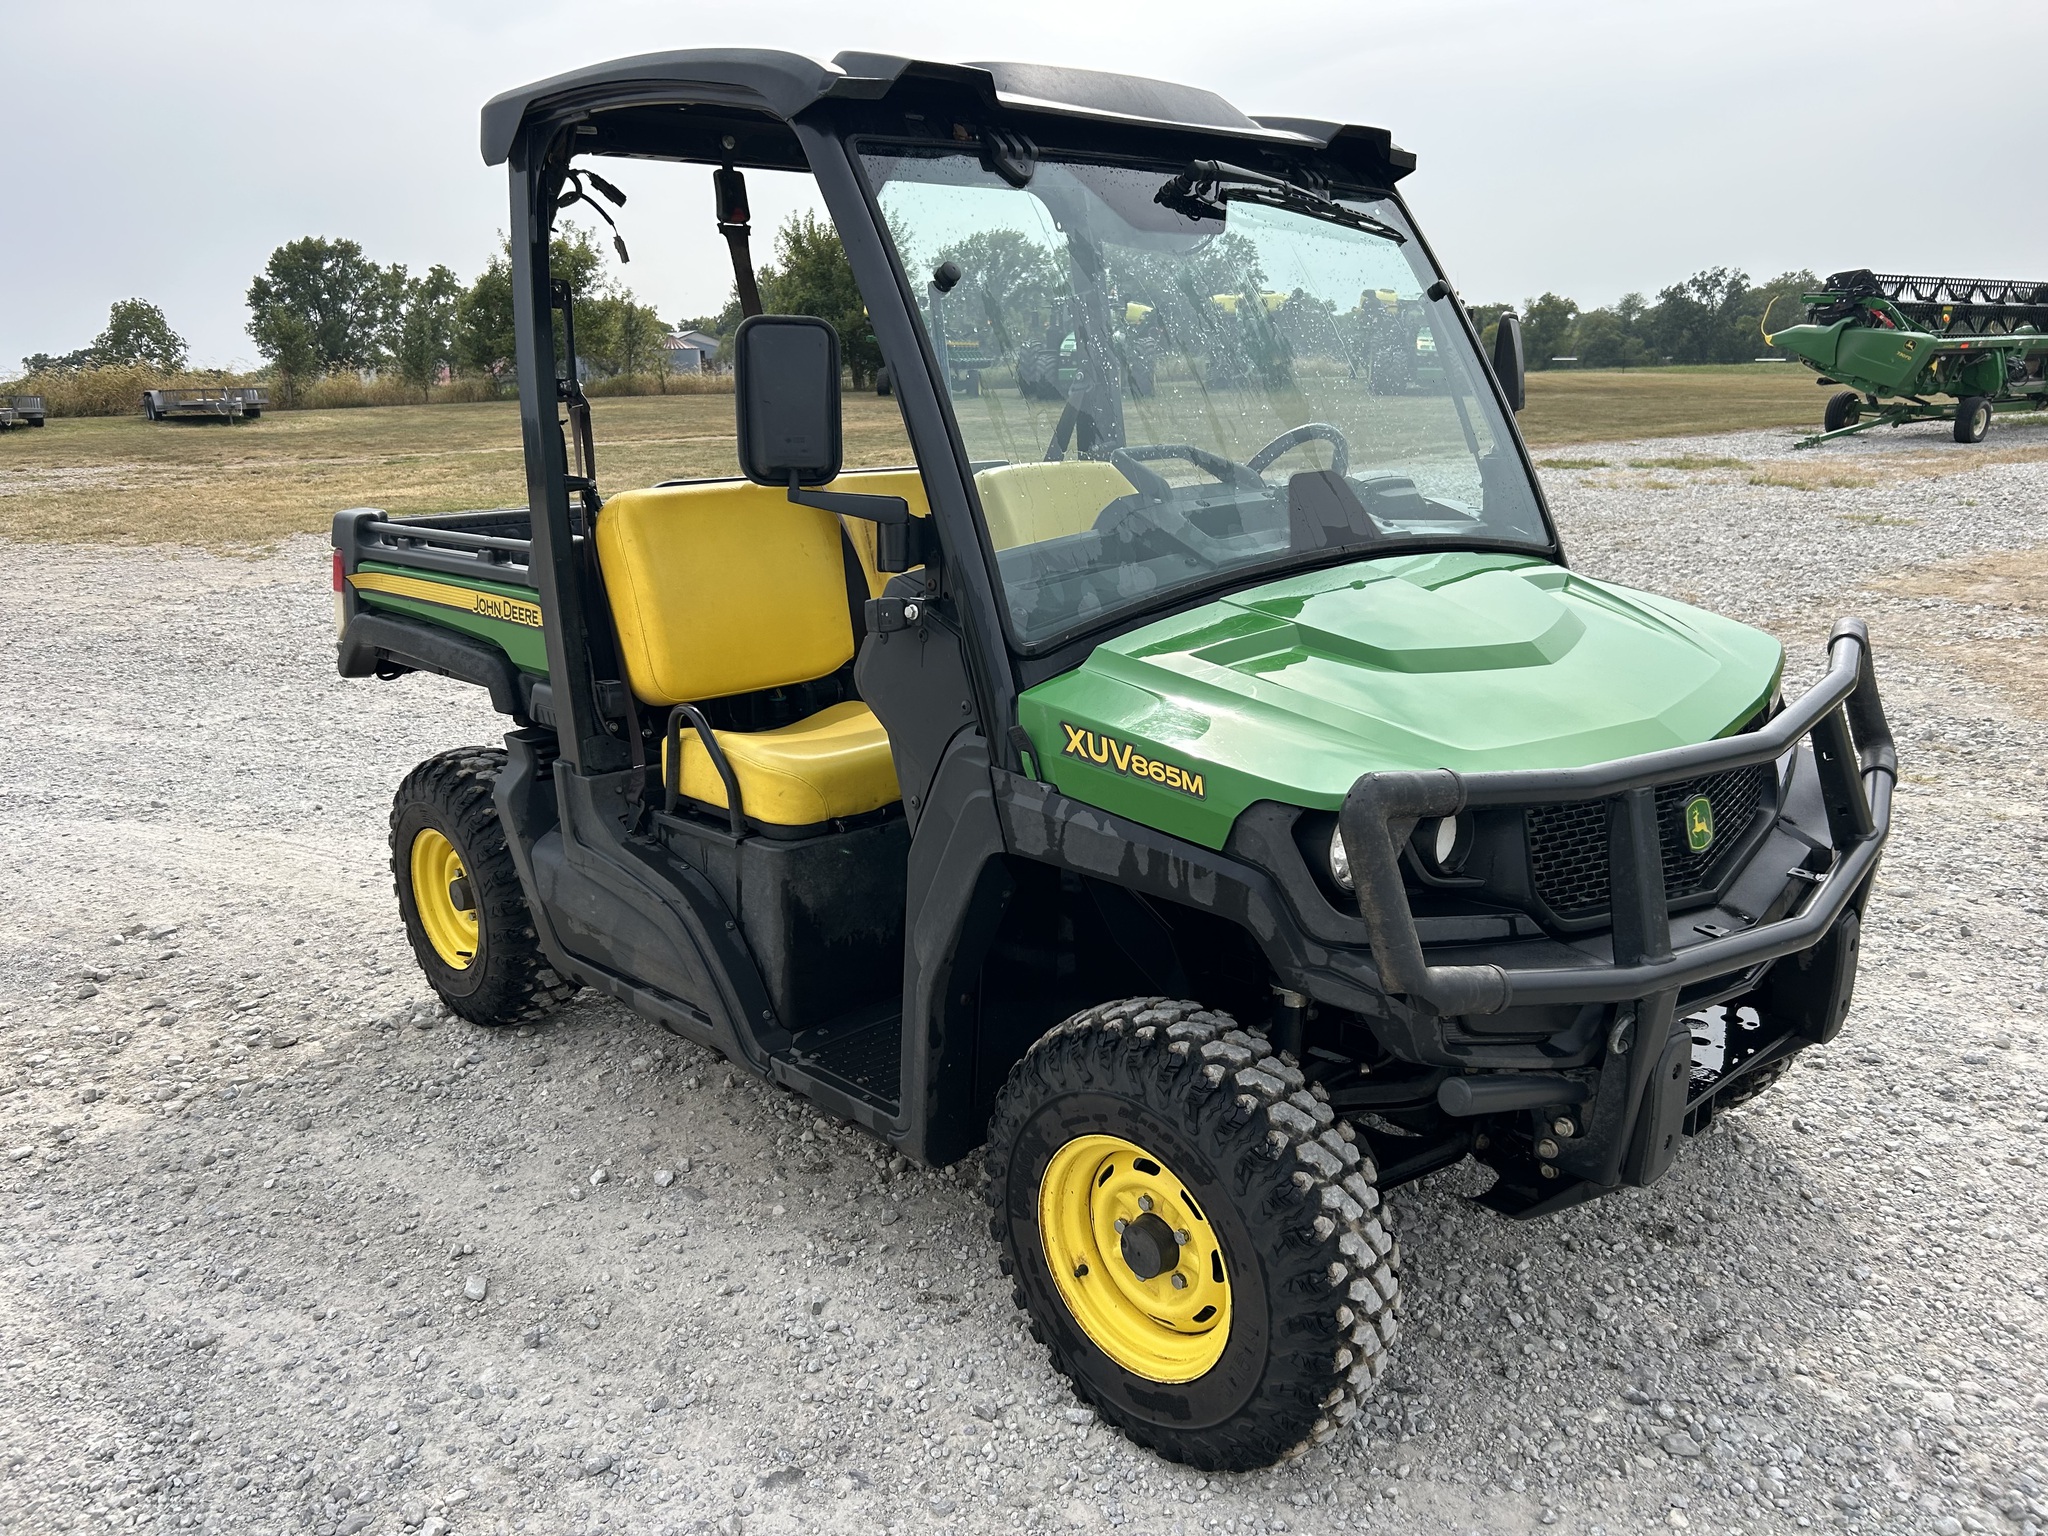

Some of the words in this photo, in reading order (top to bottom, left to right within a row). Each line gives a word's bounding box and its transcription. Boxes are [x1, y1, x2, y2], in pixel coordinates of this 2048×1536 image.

[473, 594, 502, 616] JOHN
[503, 600, 539, 625] DEERE
[1063, 723, 1206, 797] XUV865M
